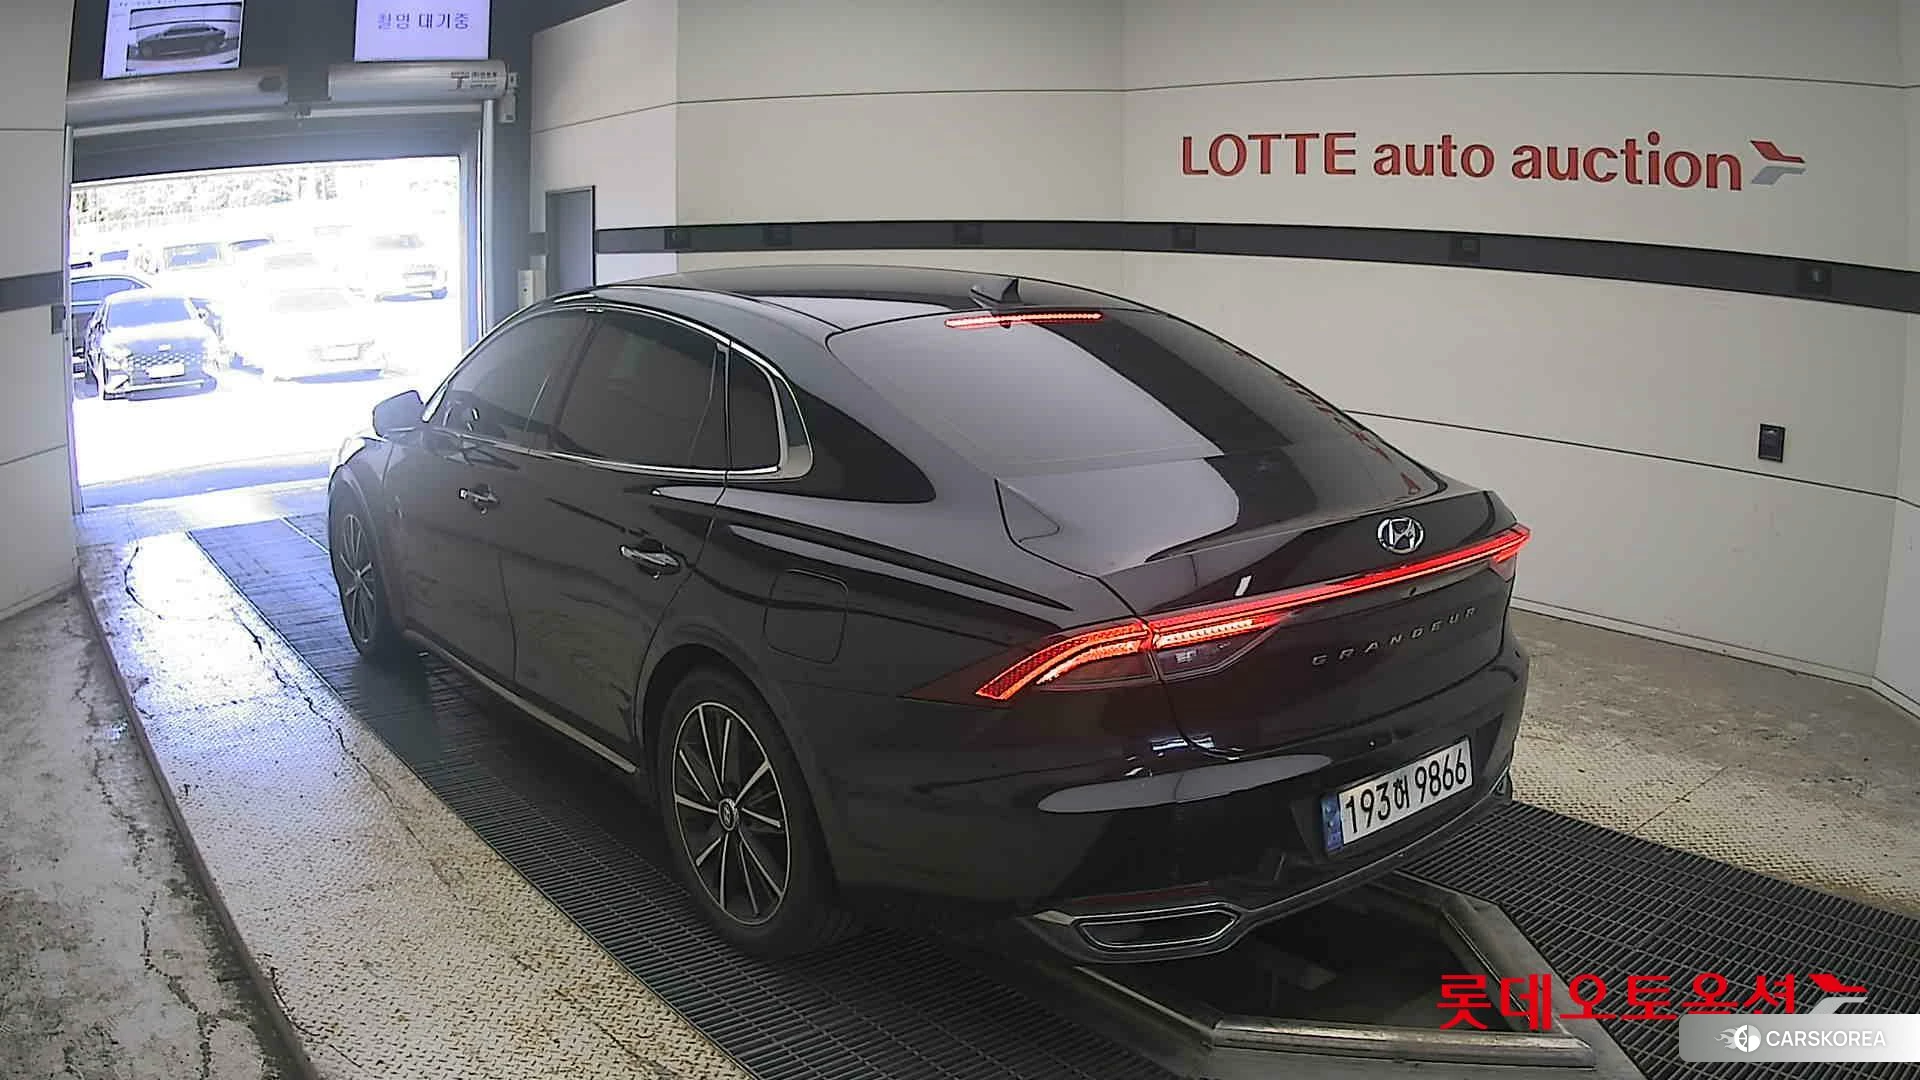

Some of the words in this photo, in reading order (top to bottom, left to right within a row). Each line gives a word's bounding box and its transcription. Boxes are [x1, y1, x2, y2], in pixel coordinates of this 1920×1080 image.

[418, 12, 469, 30] 대기중
[1181, 131, 1357, 177] LOTTE
[1373, 133, 1495, 180] auto
[1511, 131, 1743, 192] auction
[1311, 606, 1478, 667] GRANDEUR
[1414, 748, 1467, 803] 9866
